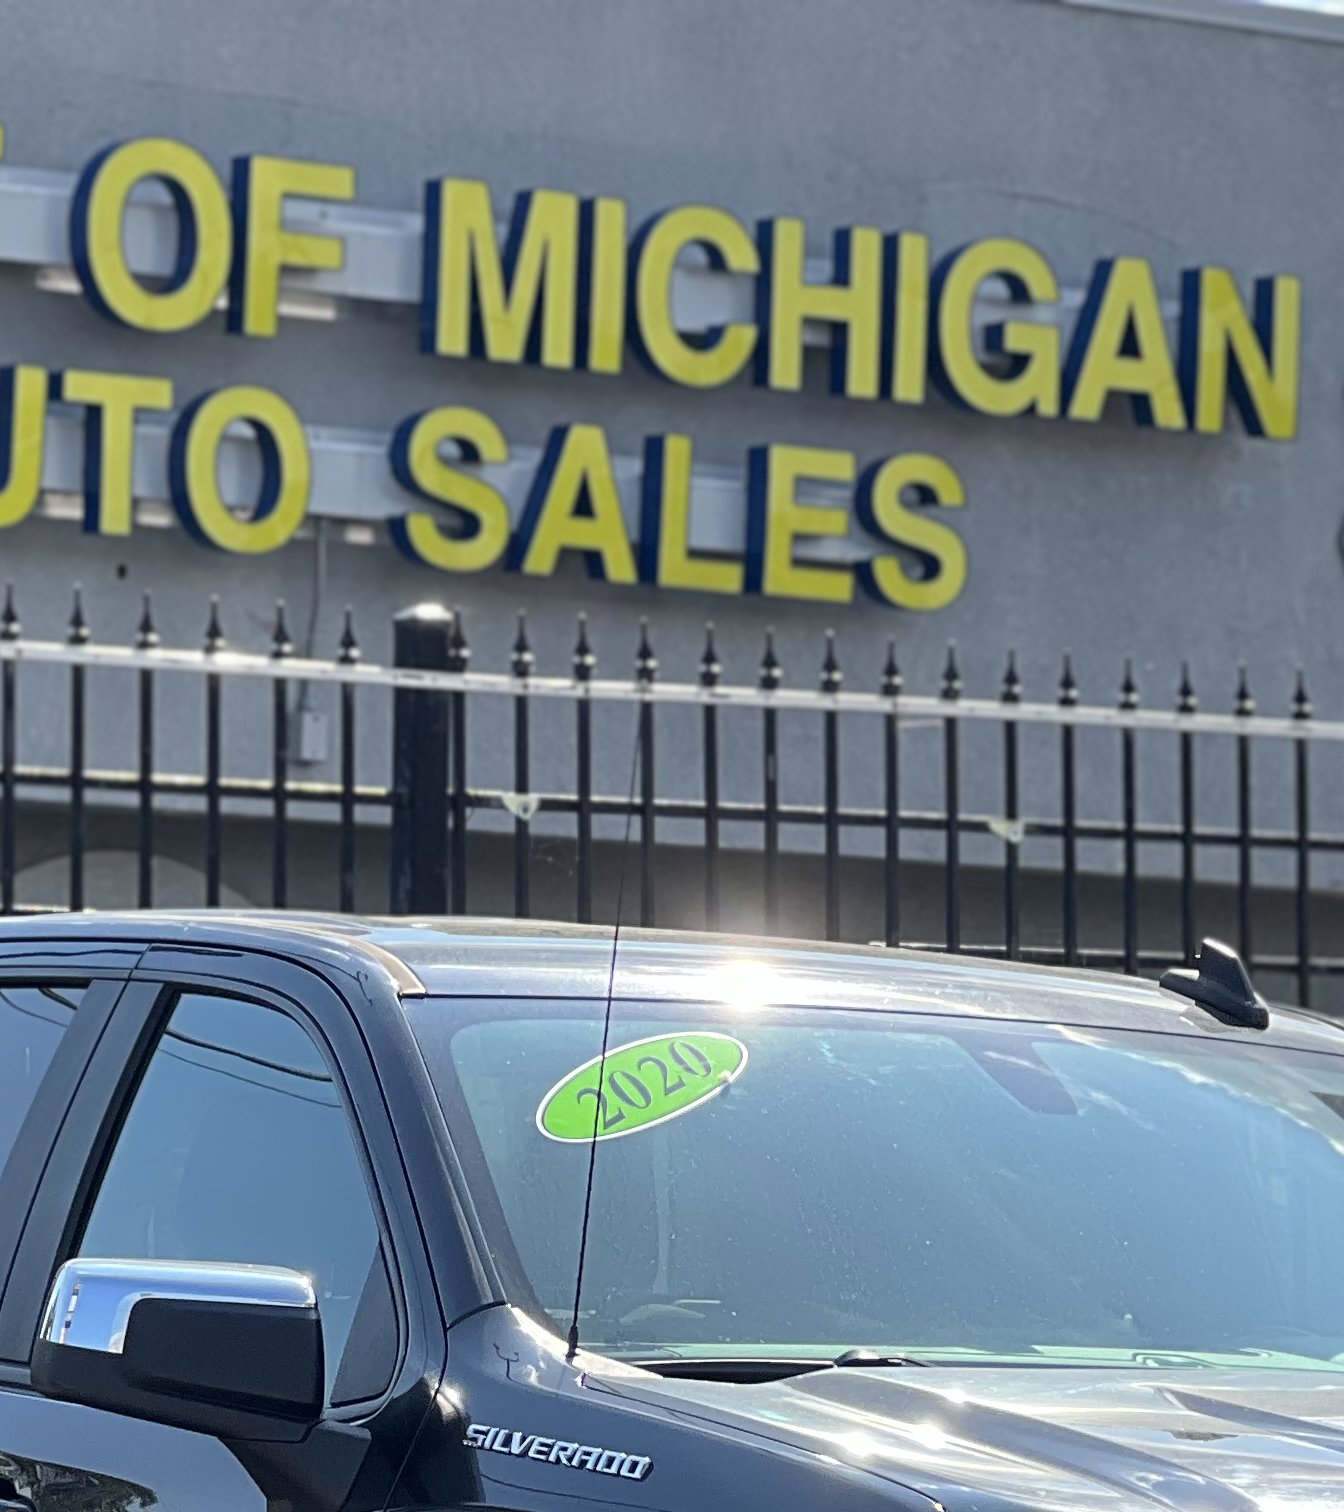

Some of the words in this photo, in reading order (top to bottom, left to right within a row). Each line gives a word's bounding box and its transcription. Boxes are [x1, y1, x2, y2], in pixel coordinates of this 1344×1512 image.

[76, 136, 356, 338] OF
[424, 175, 1302, 441] MICHIGAN
[394, 405, 968, 613] SALES
[576, 1040, 713, 1131] 2020
[463, 1424, 653, 1480] SILVERADO
